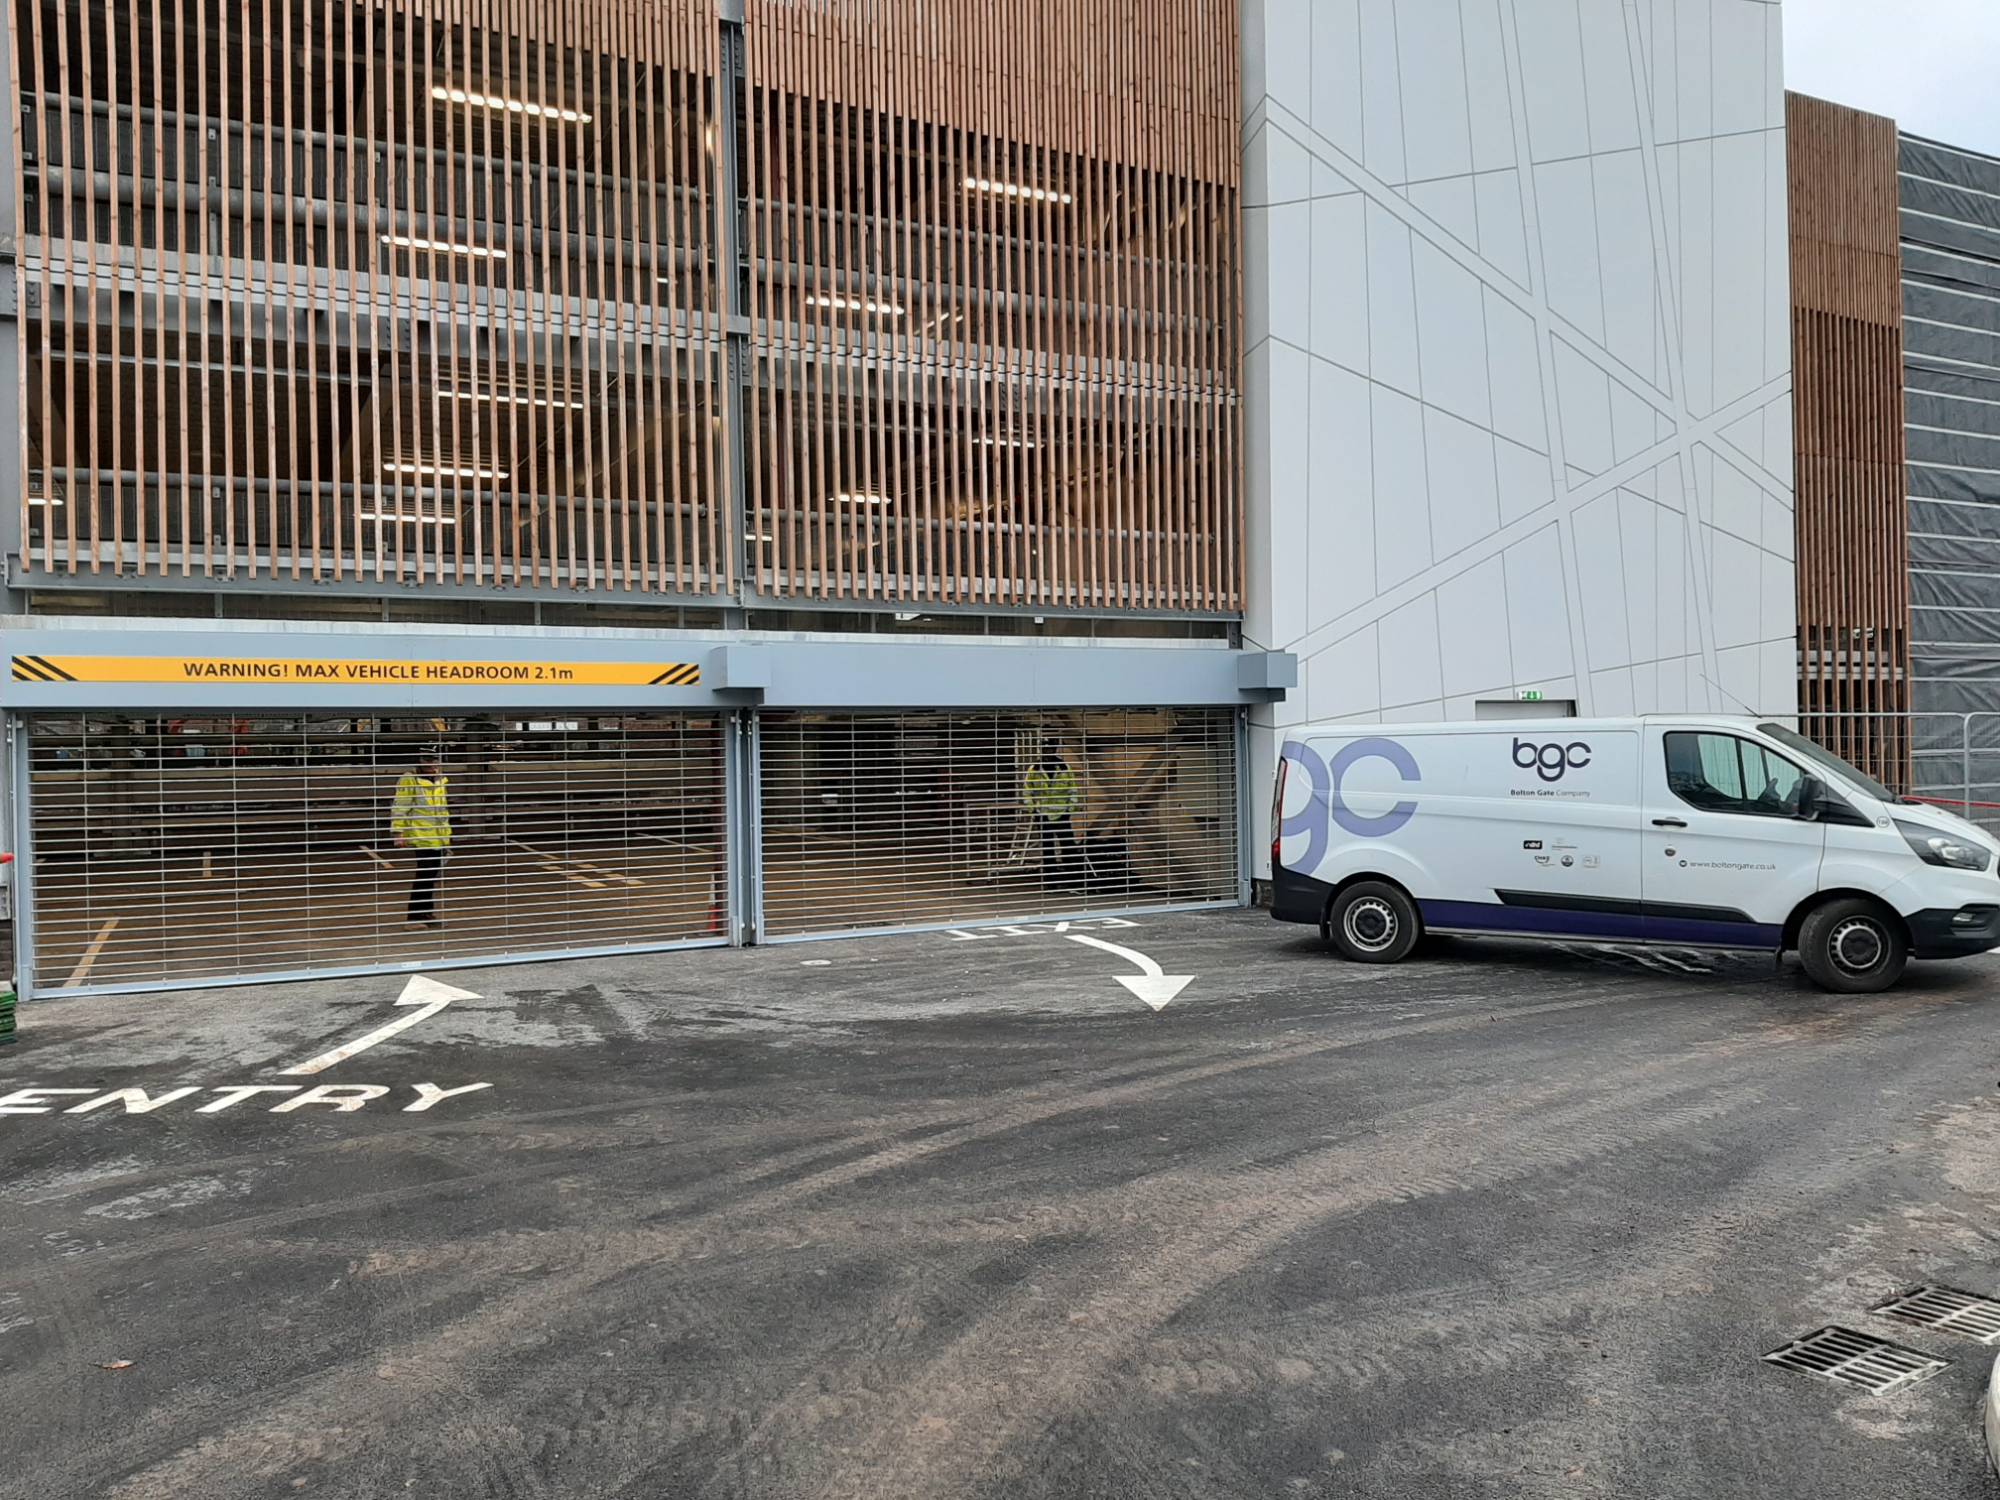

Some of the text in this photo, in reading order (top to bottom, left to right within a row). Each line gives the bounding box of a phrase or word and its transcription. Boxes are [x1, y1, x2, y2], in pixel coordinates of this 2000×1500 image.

[184, 663, 573, 679] WARNING! MAX VEHICLE HEADROOM 2.1m
[1512, 737, 1592, 782] bgc
[945, 917, 1143, 941] EXIT
[0, 1082, 494, 1114] ENTRY
